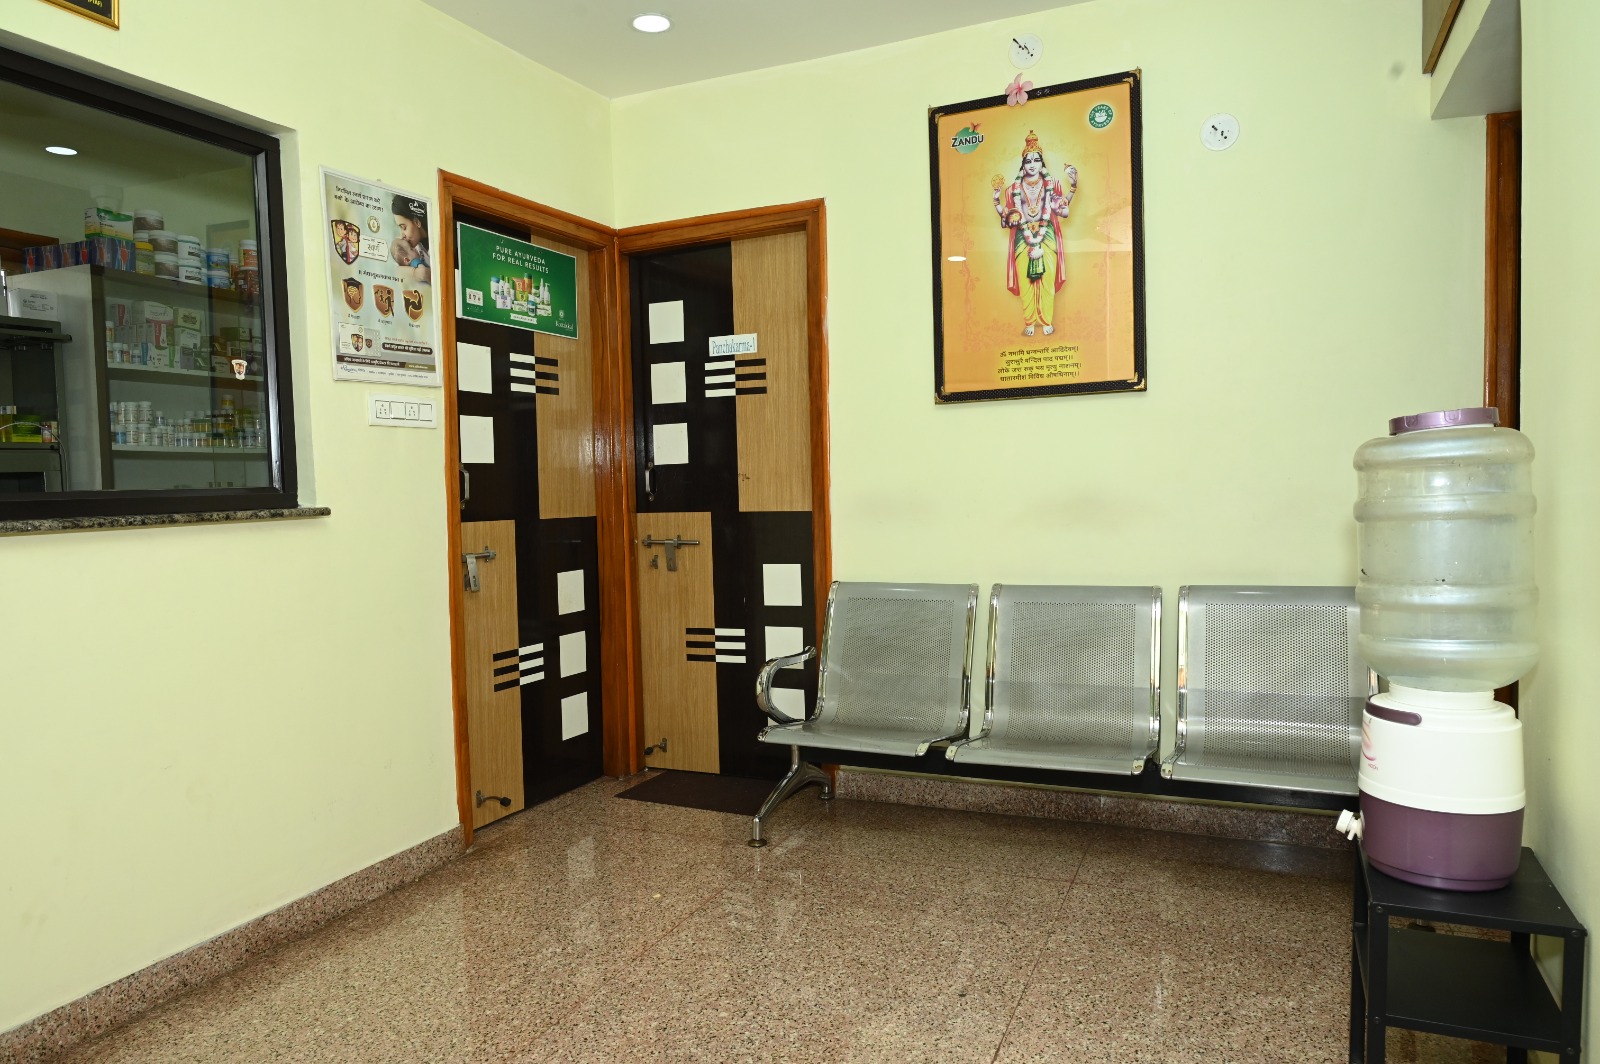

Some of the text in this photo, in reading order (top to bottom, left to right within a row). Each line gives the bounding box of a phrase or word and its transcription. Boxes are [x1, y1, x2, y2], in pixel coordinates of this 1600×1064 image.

[951, 134, 984, 148] ZANDU
[492, 252, 549, 274] FOR REAL RESULTS
[496, 245, 546, 265] PURE AYURVEDA
